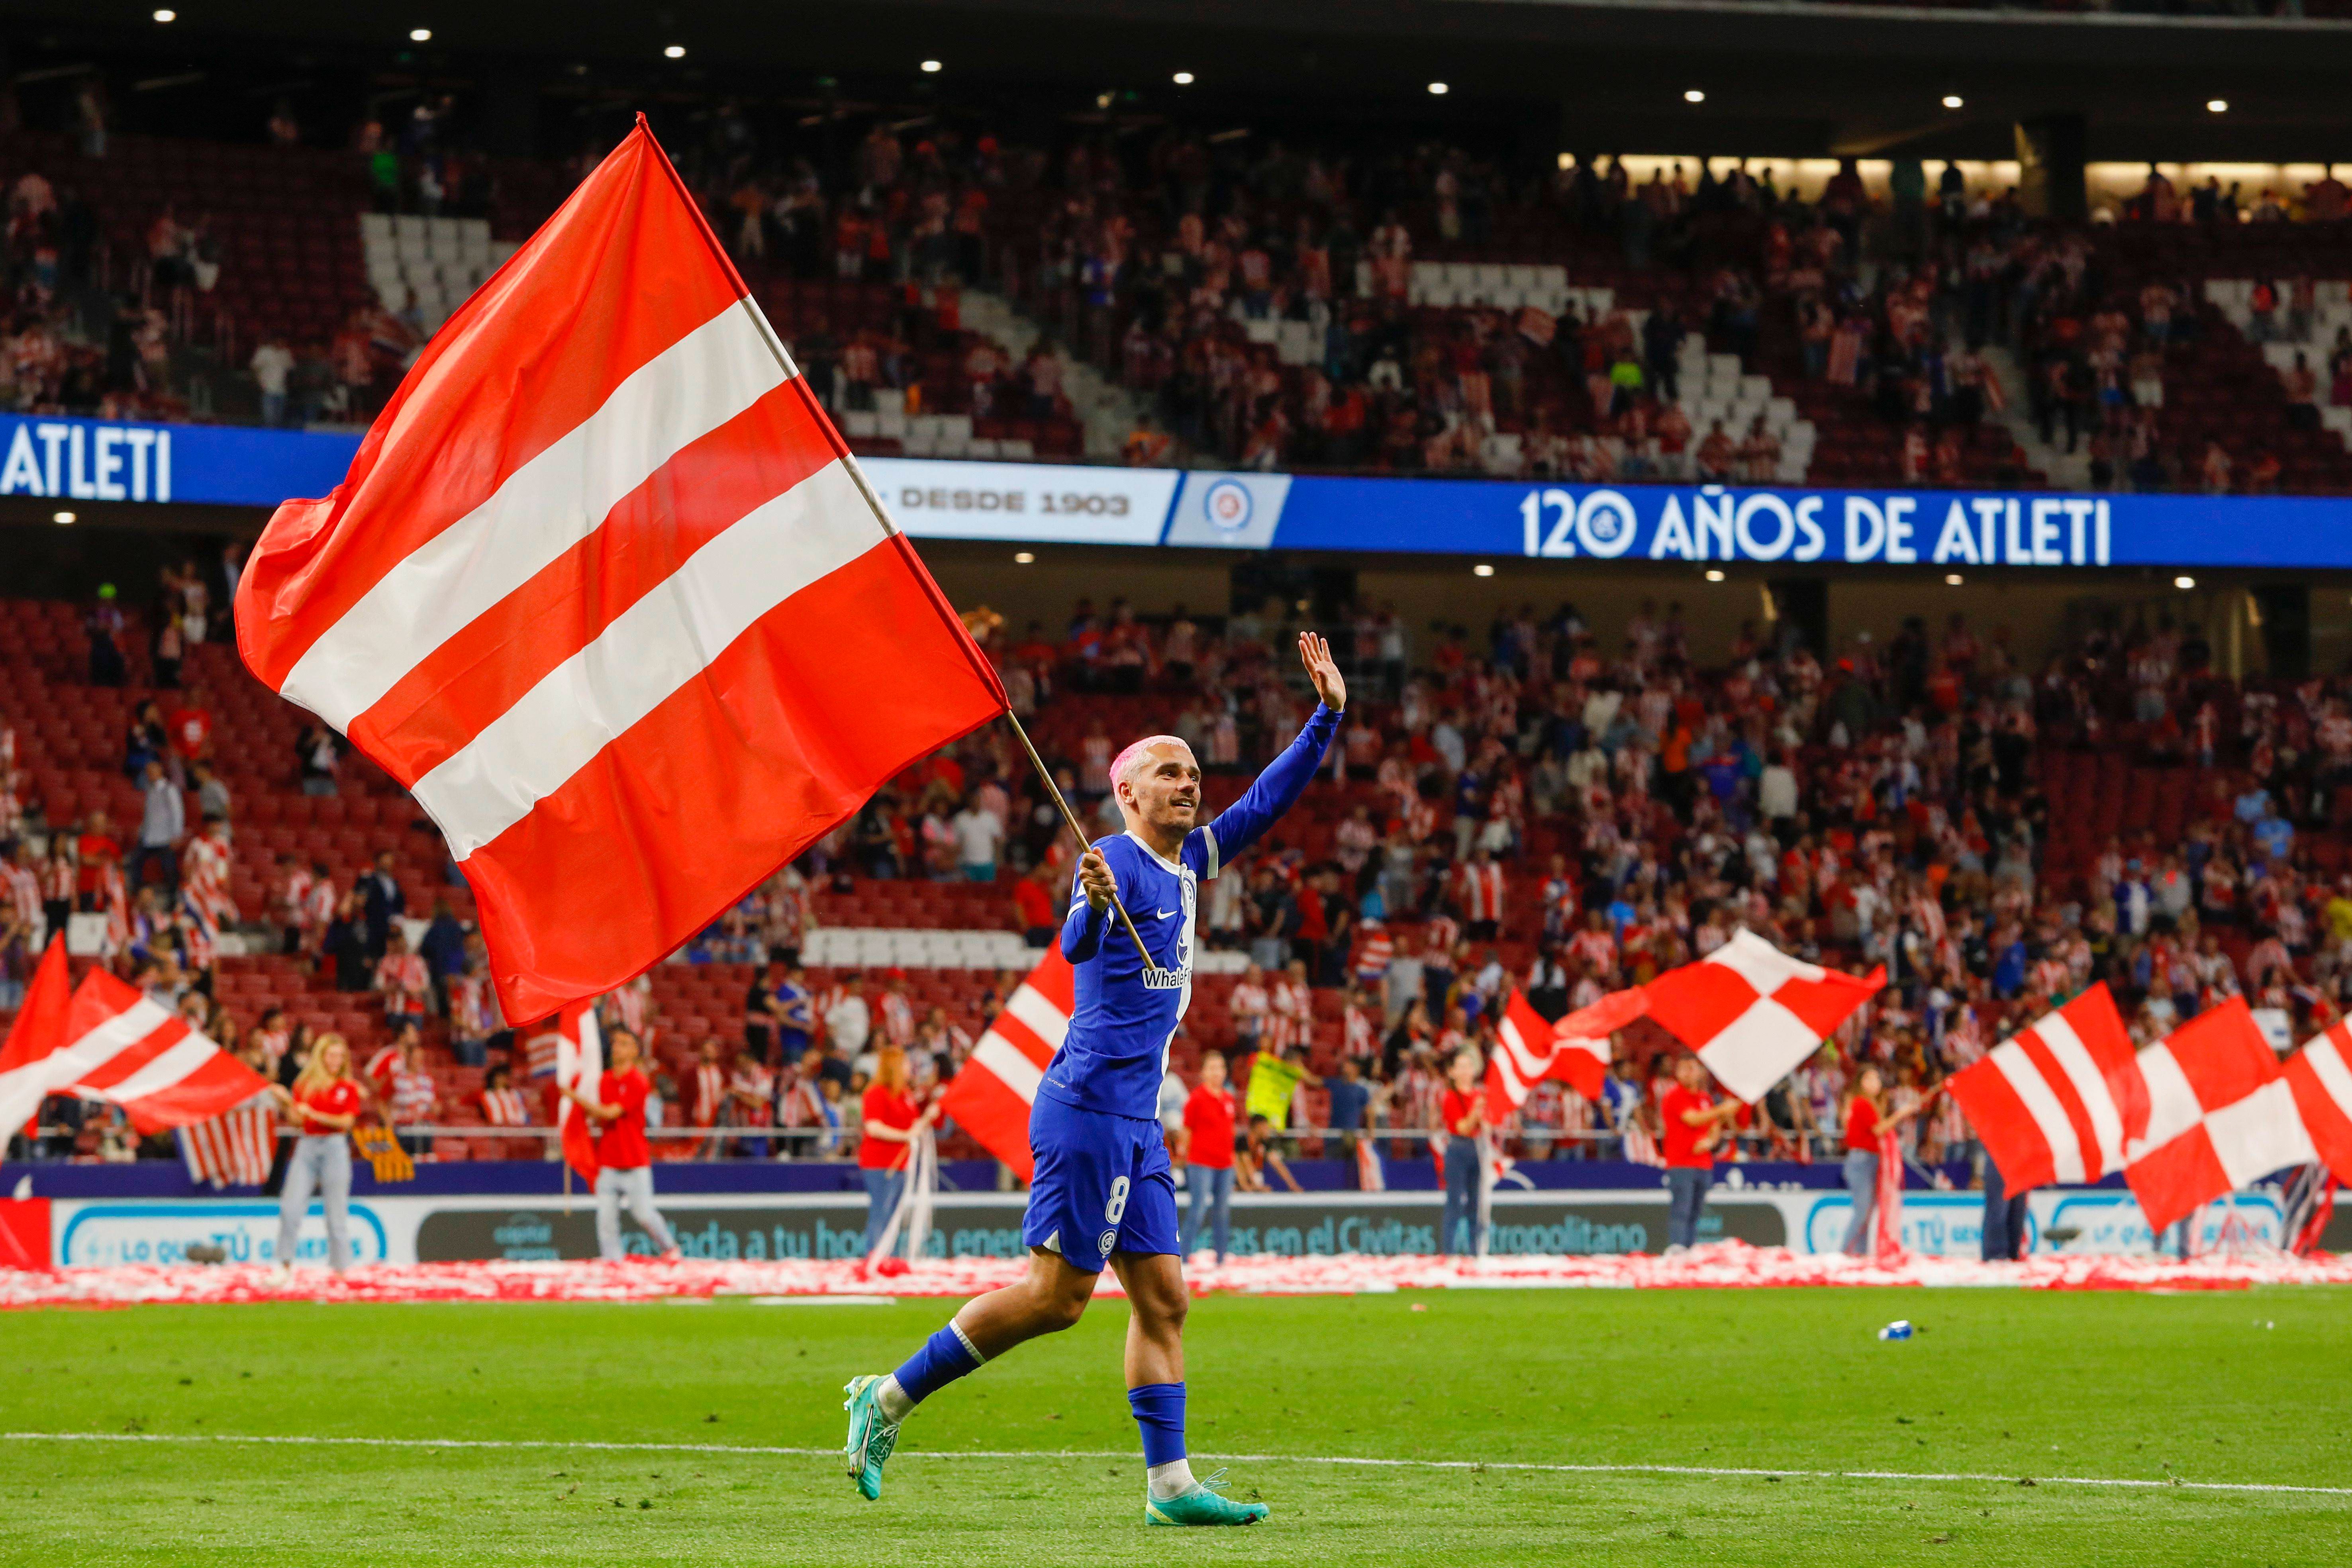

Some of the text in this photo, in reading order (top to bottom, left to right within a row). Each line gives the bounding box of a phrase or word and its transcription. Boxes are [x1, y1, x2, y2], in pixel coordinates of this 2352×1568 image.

[0, 421, 171, 503] ATLETI
[901, 487, 1130, 516] DESDE 1903
[1520, 483, 2110, 566] 120 AÑOS DE ATLETI
[1105, 1175, 1131, 1225] 8
[1307, 1216, 1334, 1255] el
